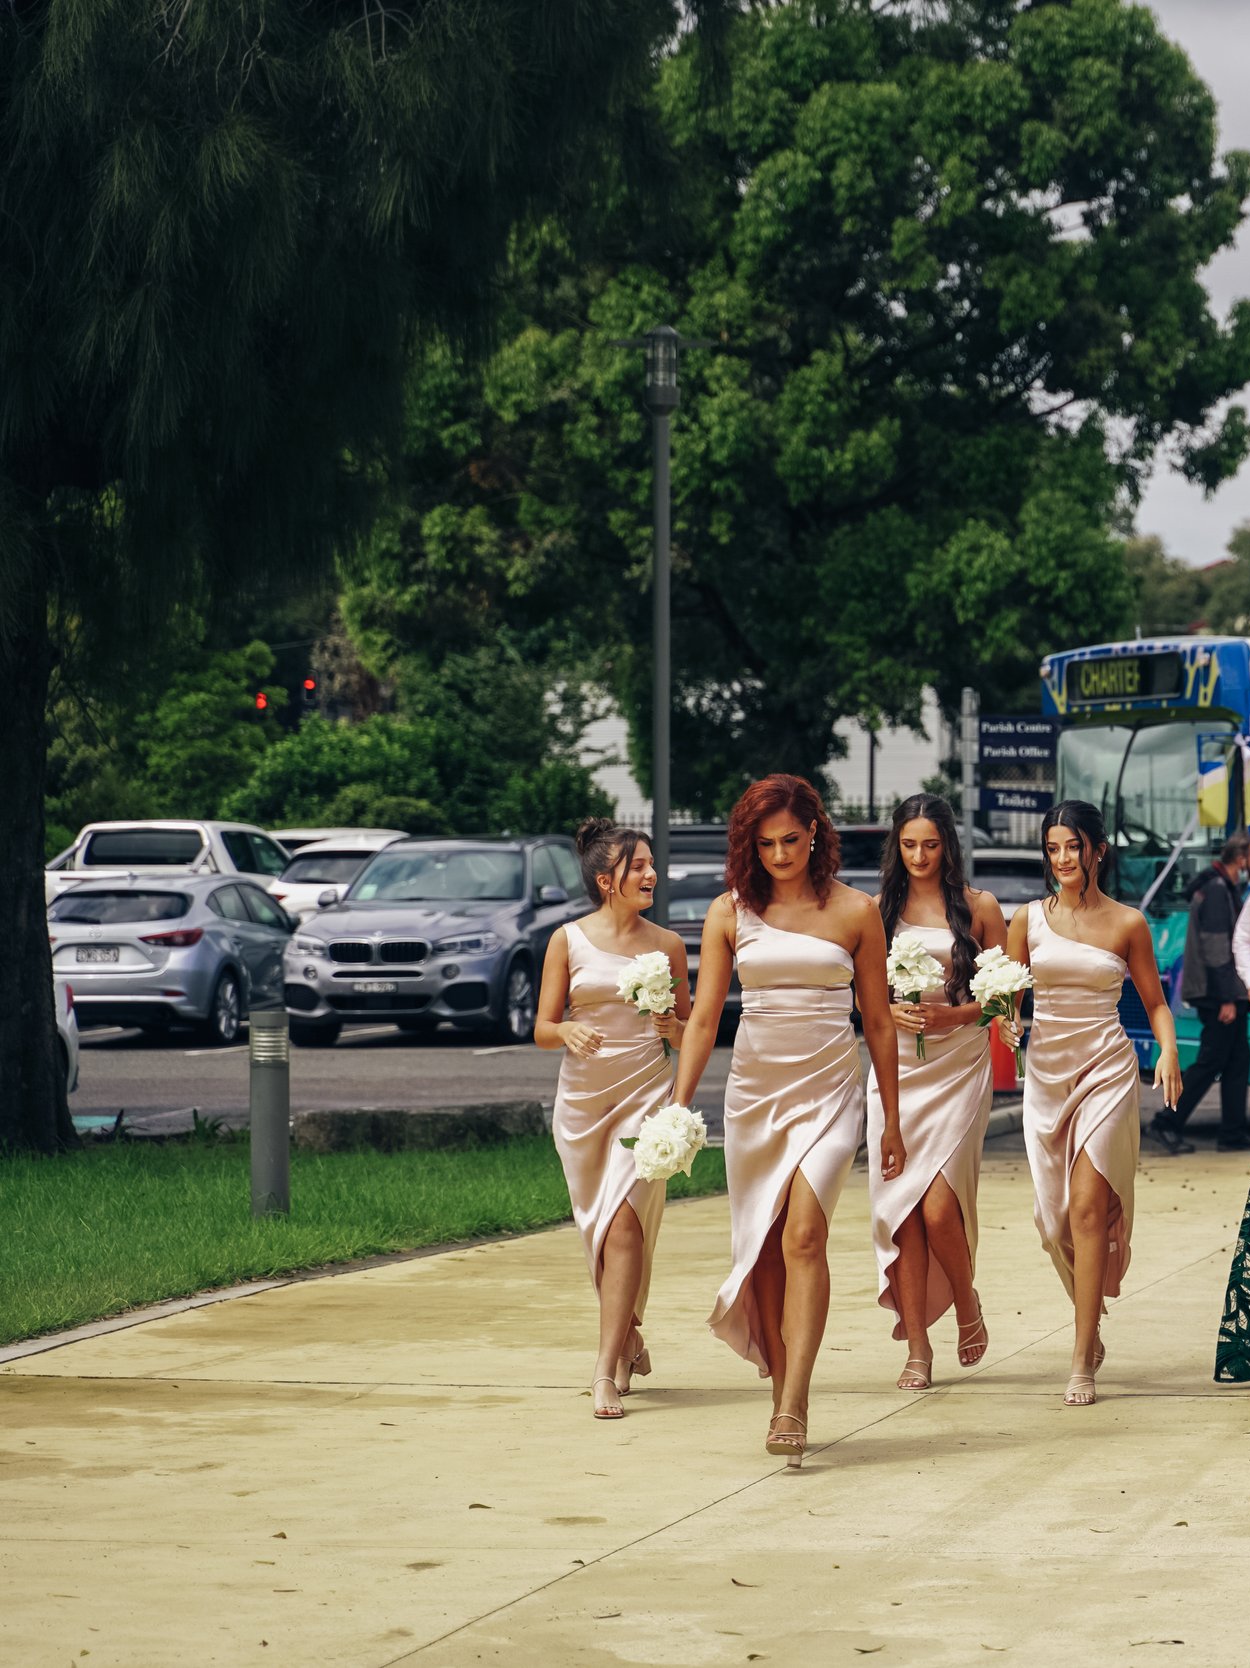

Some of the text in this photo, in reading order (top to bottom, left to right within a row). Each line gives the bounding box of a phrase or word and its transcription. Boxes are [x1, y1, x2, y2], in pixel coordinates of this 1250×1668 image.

[982, 721, 1051, 734] Parish Centre
[983, 746, 1049, 758] Parish Office
[996, 793, 1038, 808] Toilets
